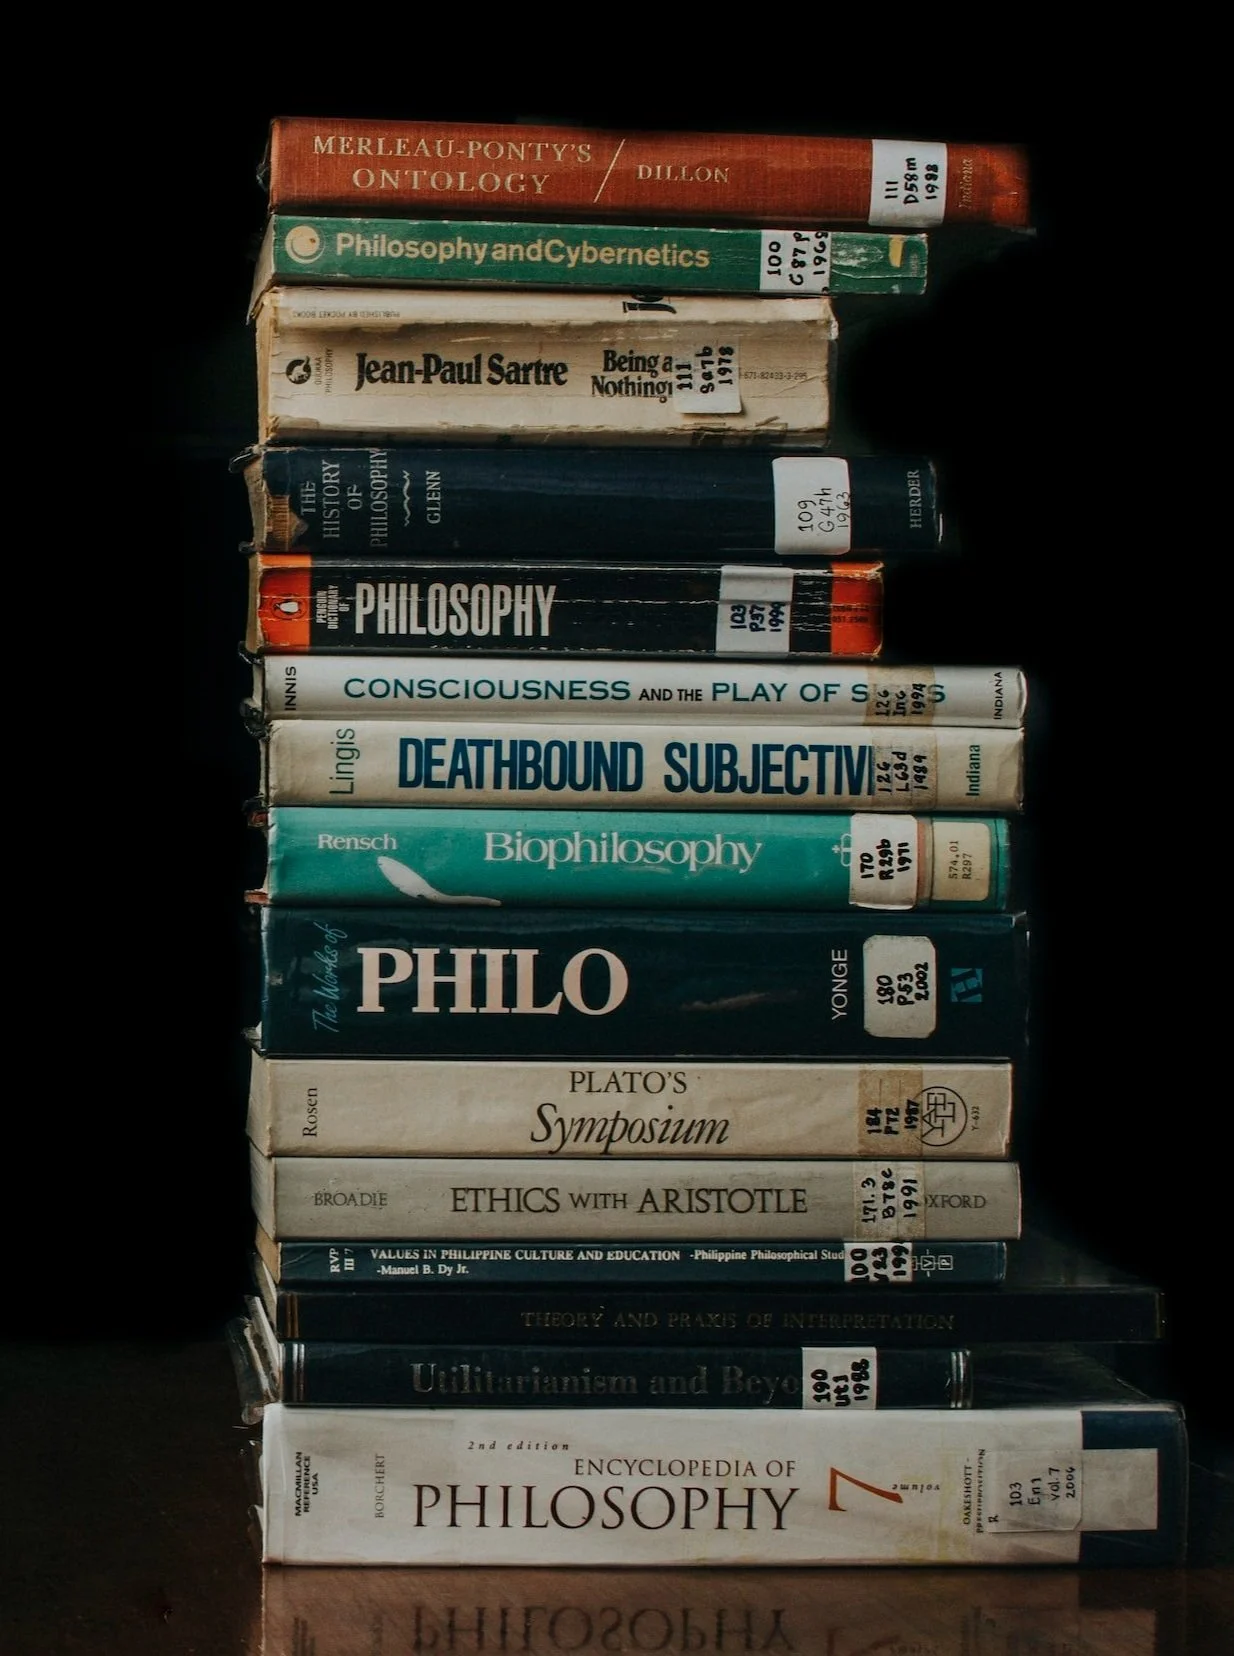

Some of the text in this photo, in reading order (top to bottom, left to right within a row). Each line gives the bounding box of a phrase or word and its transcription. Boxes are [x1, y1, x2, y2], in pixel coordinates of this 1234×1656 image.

[312, 135, 592, 163] MERLEAU-PONTY'S
[352, 168, 550, 194] ONTOLOGY
[636, 164, 729, 184] DILLON
[904, 157, 918, 205] D58m
[925, 163, 939, 200] 1988
[336, 232, 486, 265] Philosophy
[766, 240, 782, 276] 100
[325, 348, 334, 393] PHILOSOPHY
[354, 352, 568, 391] Jean-Paul Sartre
[603, 350, 659, 378] Being
[676, 362, 693, 391] 111
[718, 346, 734, 385] 1978
[591, 376, 673, 403] Nothing
[301, 481, 316, 516] THE
[322, 459, 340, 539] HISTORY
[347, 484, 363, 511] OF
[369, 449, 389, 548] PHILOSOPHY
[425, 470, 441, 524] GLENN
[907, 469, 922, 529] HERDER
[797, 499, 817, 532] 109
[316, 590, 328, 624] PENGUIN
[327, 584, 339, 630] DICTIONARY
[338, 602, 350, 612] OF
[355, 582, 556, 636] PHILOSOPHY
[730, 604, 747, 630] 103
[284, 666, 297, 712] INNIS
[344, 678, 631, 701] CONSCIOUSNESS
[639, 688, 673, 702] AND
[677, 688, 703, 702] THE
[712, 682, 788, 702] PLAY
[800, 683, 841, 703] OF
[875, 689, 890, 717] 126
[993, 671, 1003, 720] INDIANA
[329, 727, 361, 795] Lingis
[398, 737, 644, 793] DEATHBOUND
[876, 761, 892, 793] 126
[966, 745, 981, 797] Indiana
[317, 833, 398, 851] Rensch
[484, 831, 763, 874] Biophilosophy
[897, 842, 913, 873] 1971
[860, 852, 874, 879] 170
[948, 840, 959, 880] 574.01
[962, 853, 973, 880] R297
[312, 920, 348, 1034] The Works of
[356, 947, 629, 1016] PHILO
[831, 949, 848, 1021] YONGE
[876, 974, 896, 1005] 180
[897, 973, 915, 1006] P53
[914, 962, 929, 1001] 2002
[569, 1070, 688, 1094] PLATO'S
[302, 1087, 318, 1138] Rosen
[530, 1102, 730, 1155] Symposium
[971, 1106, 980, 1131] Y-632
[314, 1192, 388, 1208] BROADIE
[450, 1187, 808, 1214] ETHICS WITH ARISTOTLE
[901, 1178, 919, 1218] 1991
[924, 1195, 986, 1209] XFORD
[329, 1248, 341, 1273] RVP
[344, 1258, 355, 1271] III
[370, 1249, 420, 1260] VALUES
[423, 1249, 437, 1260] IN
[440, 1249, 512, 1260] PHILIPPINE
[515, 1249, 574, 1261] CULTURE
[577, 1249, 603, 1261] AND
[606, 1249, 681, 1261] EDUCATION
[750, 1249, 818, 1262] Philosophical
[821, 1249, 845, 1261] Stud
[422, 1264, 434, 1275] B.
[437, 1264, 453, 1277] Dy
[456, 1264, 469, 1275] Jr.
[891, 1240, 911, 1276] 199
[520, 1312, 954, 1330] THEORY AND PRAXIS OF INTERPRETATION
[410, 1363, 801, 1404] Utilitarianism and Beyo
[810, 1368, 831, 1404] 190
[468, 1441, 569, 1451] 2nd edition
[295, 1451, 303, 1517] MACMILLAN
[575, 1458, 796, 1478] ENCYCLOPEDIA OF
[375, 1453, 386, 1519] BORCHERT
[828, 1466, 904, 1512] 7
[891, 1483, 941, 1494] volume
[962, 1464, 973, 1525] OAKESHOTT
[1009, 1482, 1023, 1507] 103
[412, 1484, 800, 1530] PHILOSOPHY
